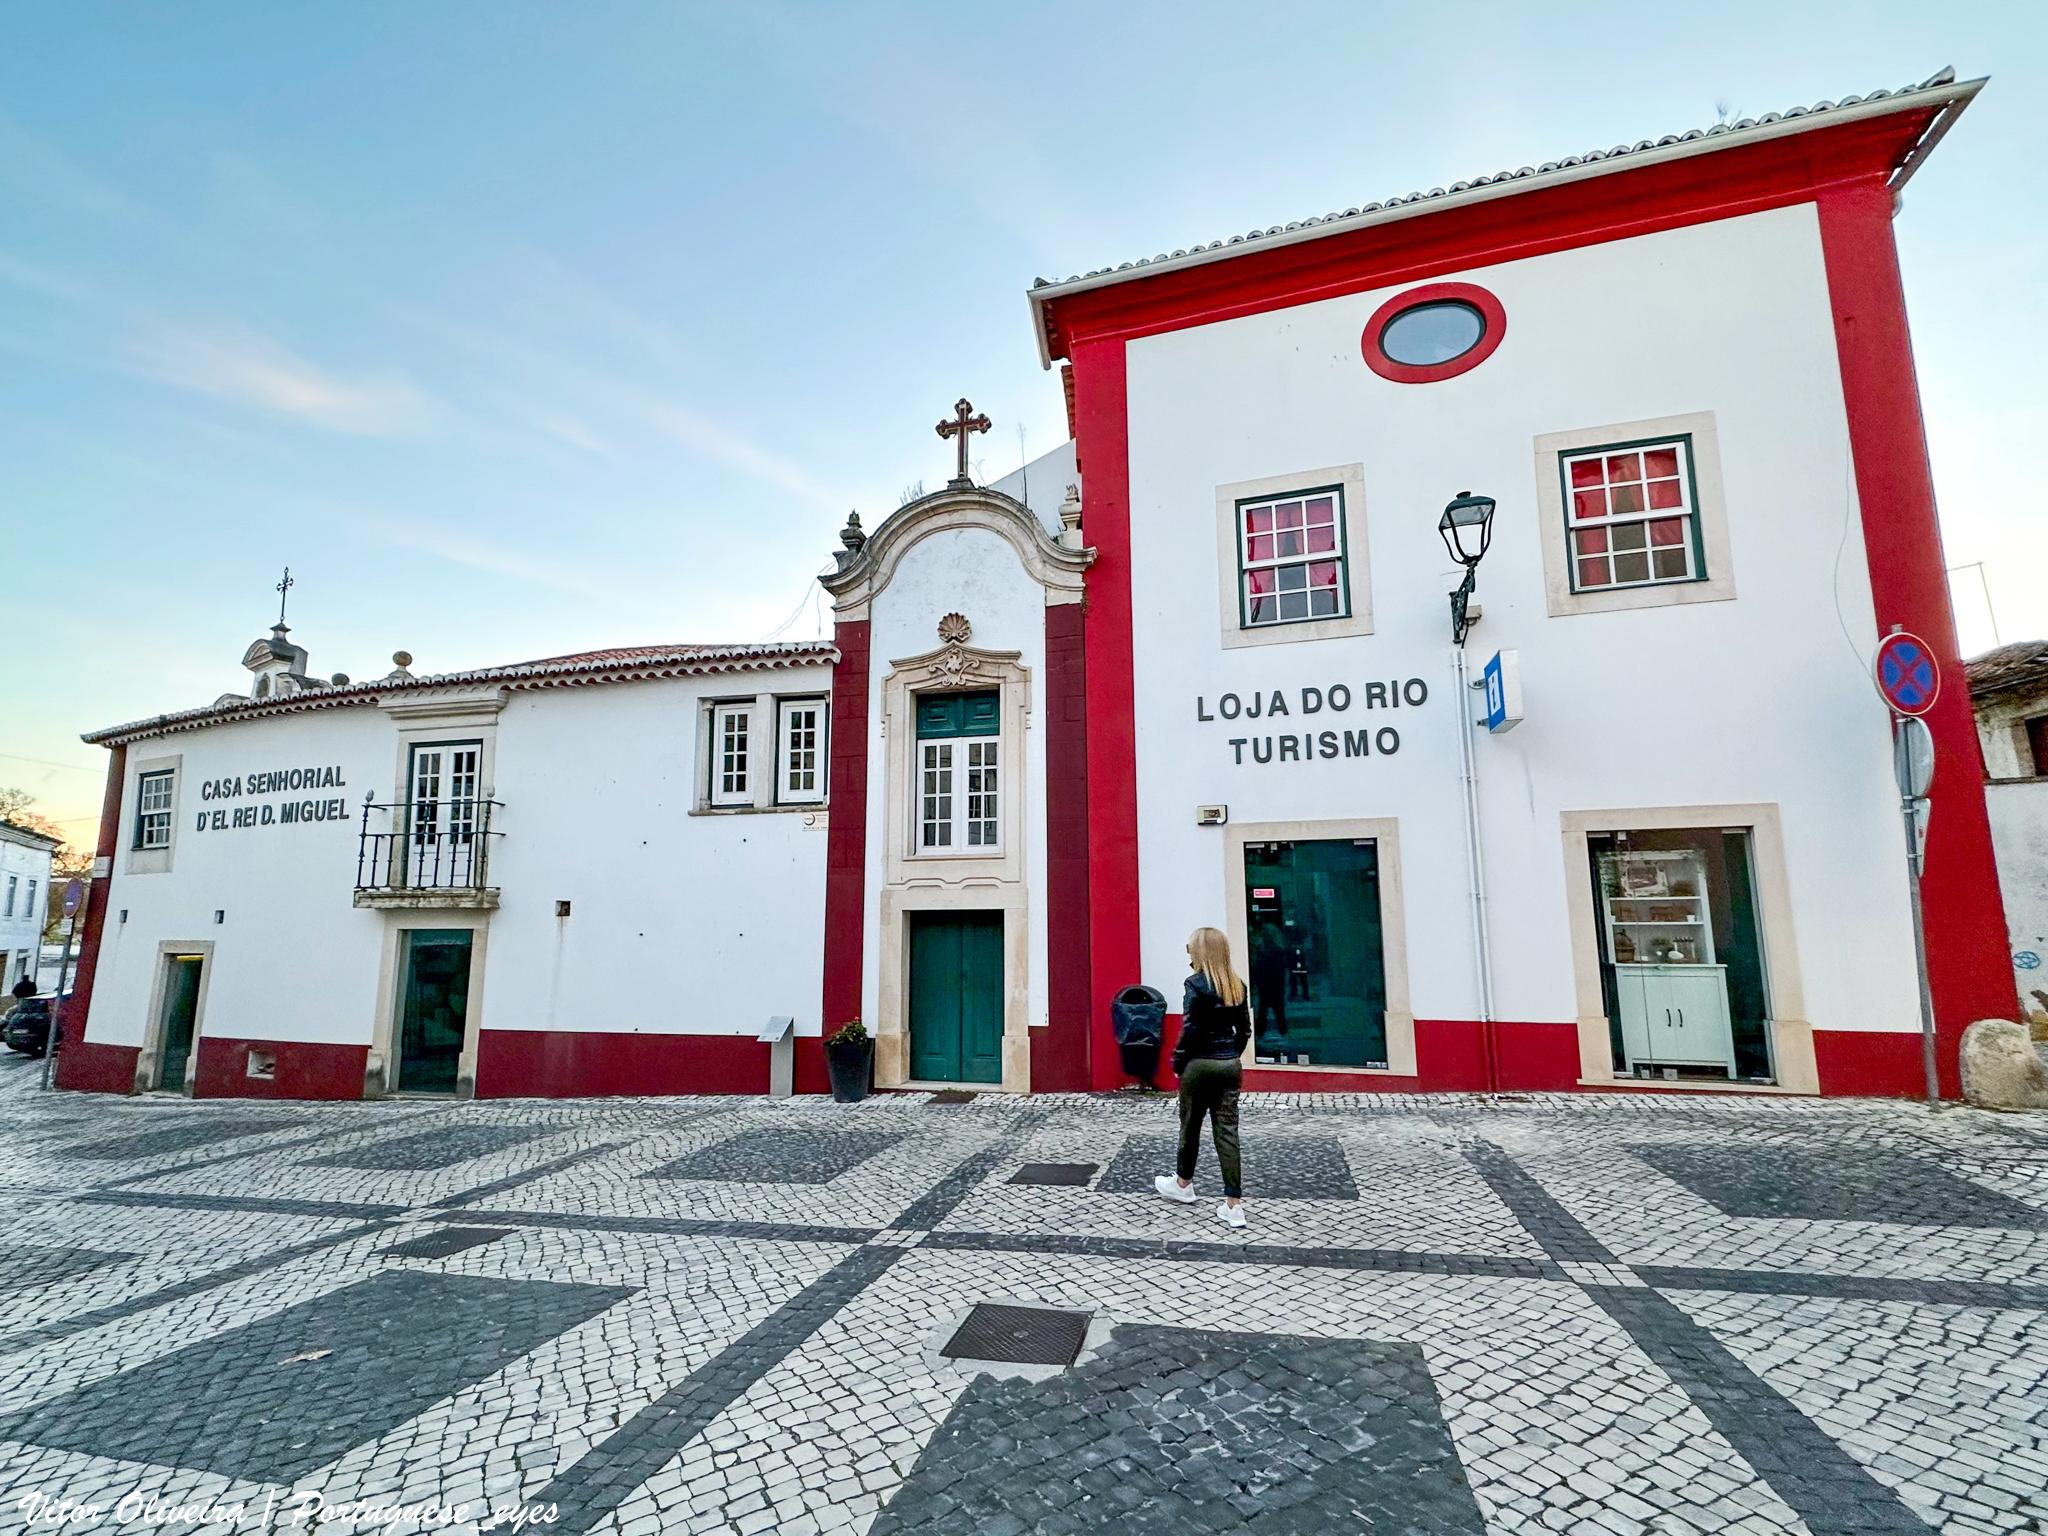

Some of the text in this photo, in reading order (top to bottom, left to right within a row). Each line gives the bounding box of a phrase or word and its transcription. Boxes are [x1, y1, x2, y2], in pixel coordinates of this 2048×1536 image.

[1197, 678, 1428, 722] LOJA DO RIO
[1228, 726, 1400, 765] TURISMO
[201, 765, 346, 801] CASA SENHORIAL
[232, 806, 258, 828] REI
[260, 804, 276, 826] D.
[280, 798, 350, 824] MIGUEL
